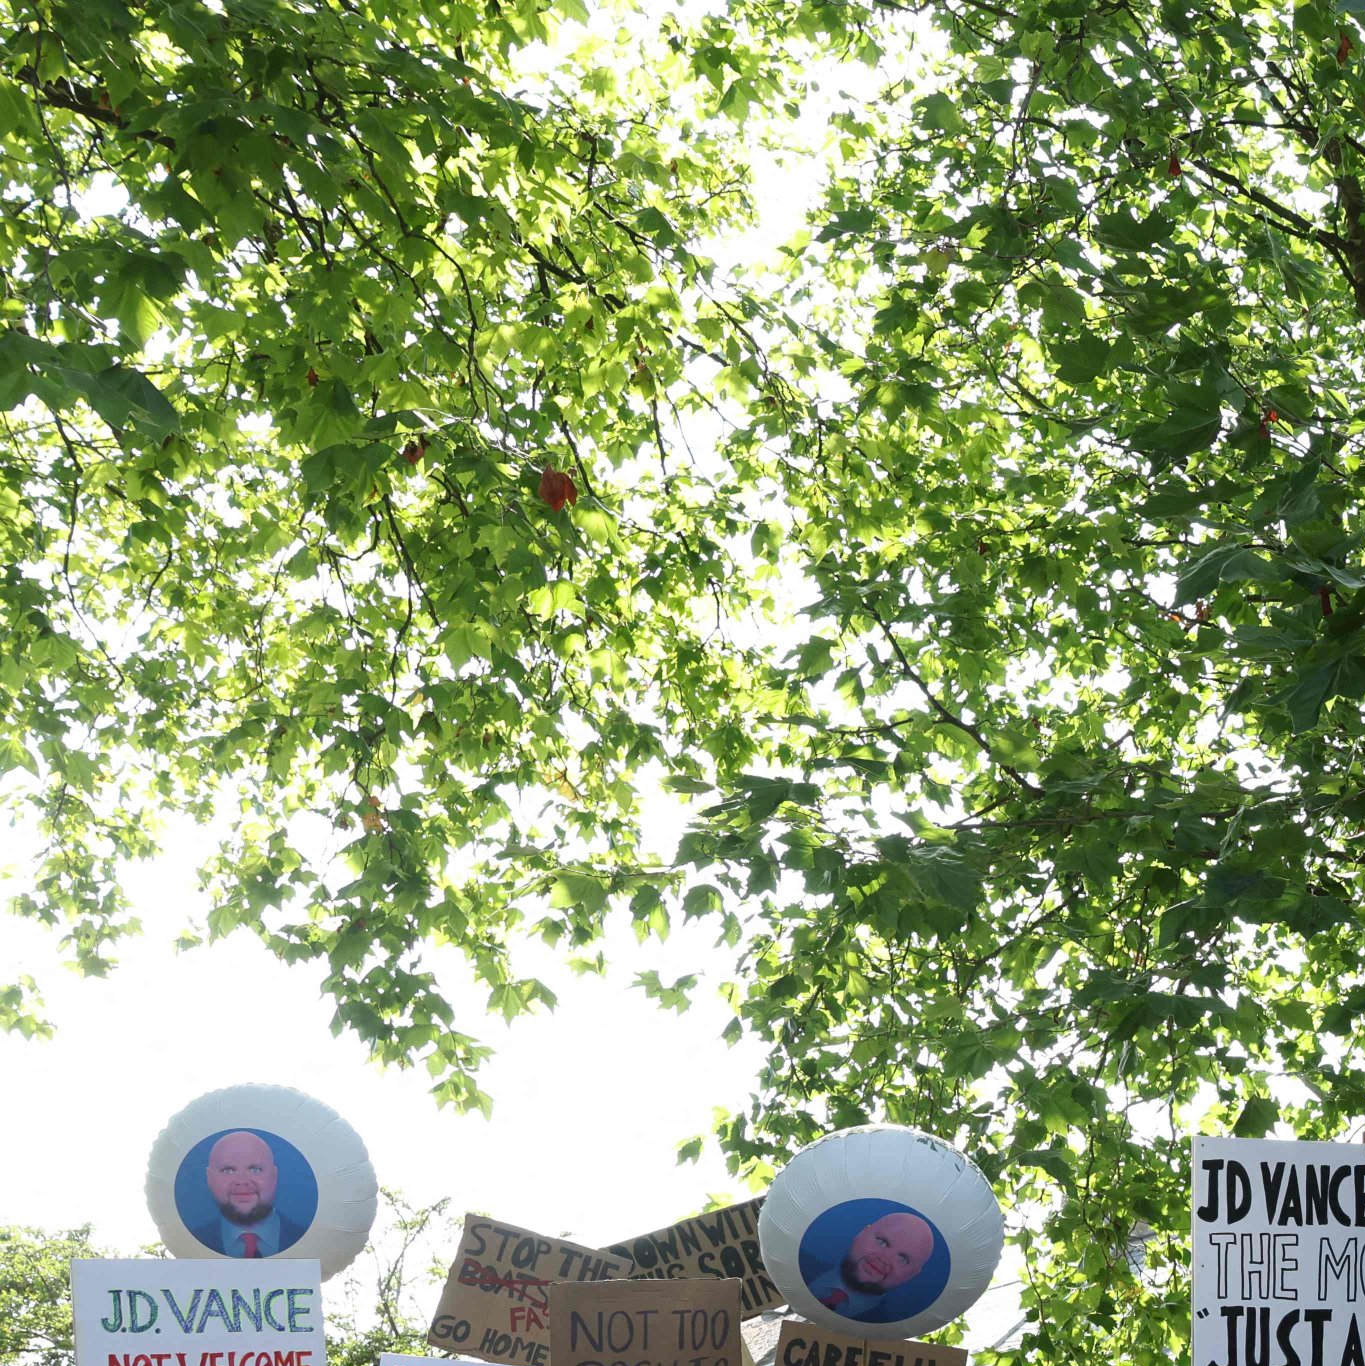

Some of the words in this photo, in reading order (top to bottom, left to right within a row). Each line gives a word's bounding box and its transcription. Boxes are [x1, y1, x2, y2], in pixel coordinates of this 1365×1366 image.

[1197, 1159, 1252, 1225] JD
[463, 1222, 550, 1272] STOP
[1209, 1233, 1298, 1300] THE
[101, 1289, 161, 1334] J.D.
[161, 1288, 314, 1334] VANCE
[431, 1315, 471, 1343] GO
[570, 1309, 659, 1353] NOT
[671, 1309, 730, 1351] TOO
